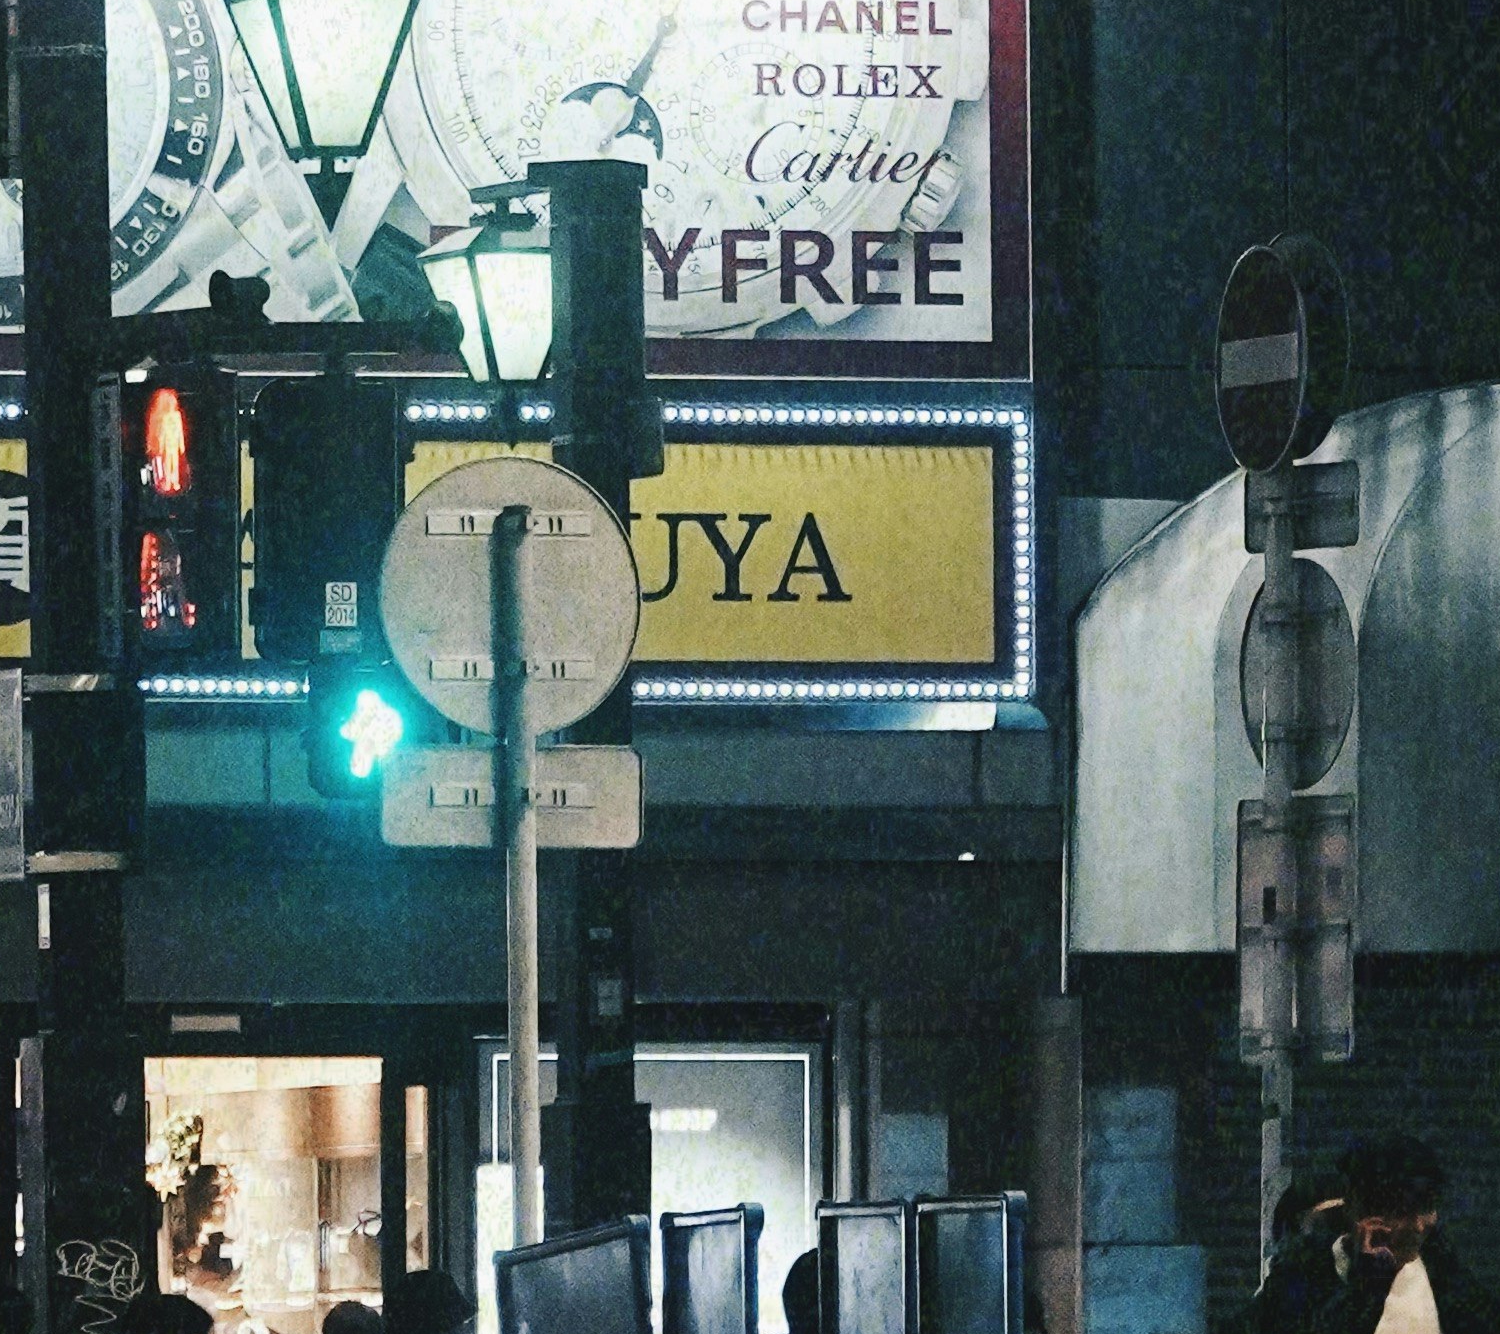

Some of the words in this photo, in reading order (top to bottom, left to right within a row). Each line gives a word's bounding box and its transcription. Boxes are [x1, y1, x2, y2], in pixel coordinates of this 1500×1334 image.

[177, 0, 206, 48] 200
[741, 0, 953, 37] CHANEL
[752, 62, 943, 100] ROLEX
[186, 112, 211, 157] 160
[744, 120, 954, 185] Cartier
[642, 227, 965, 307] YFREE
[330, 584, 352, 602] SD
